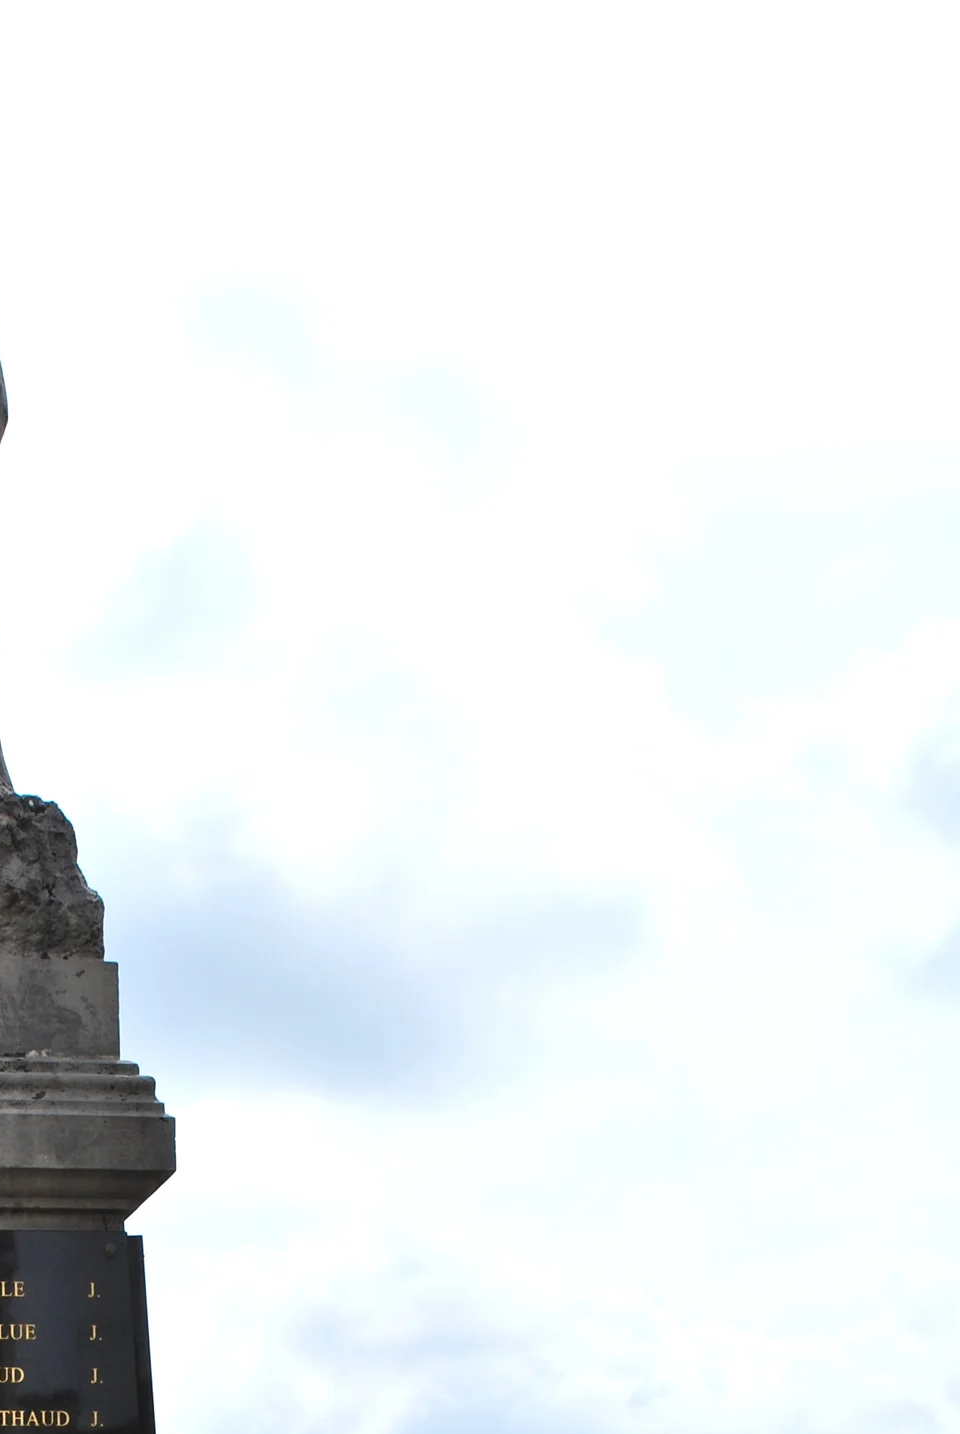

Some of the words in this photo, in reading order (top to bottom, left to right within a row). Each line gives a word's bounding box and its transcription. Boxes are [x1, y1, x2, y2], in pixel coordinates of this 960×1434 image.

[87, 1282, 101, 1298] J.
[89, 1325, 103, 1341] J.
[90, 1368, 104, 1384] J.
[91, 1411, 104, 1427] J.
